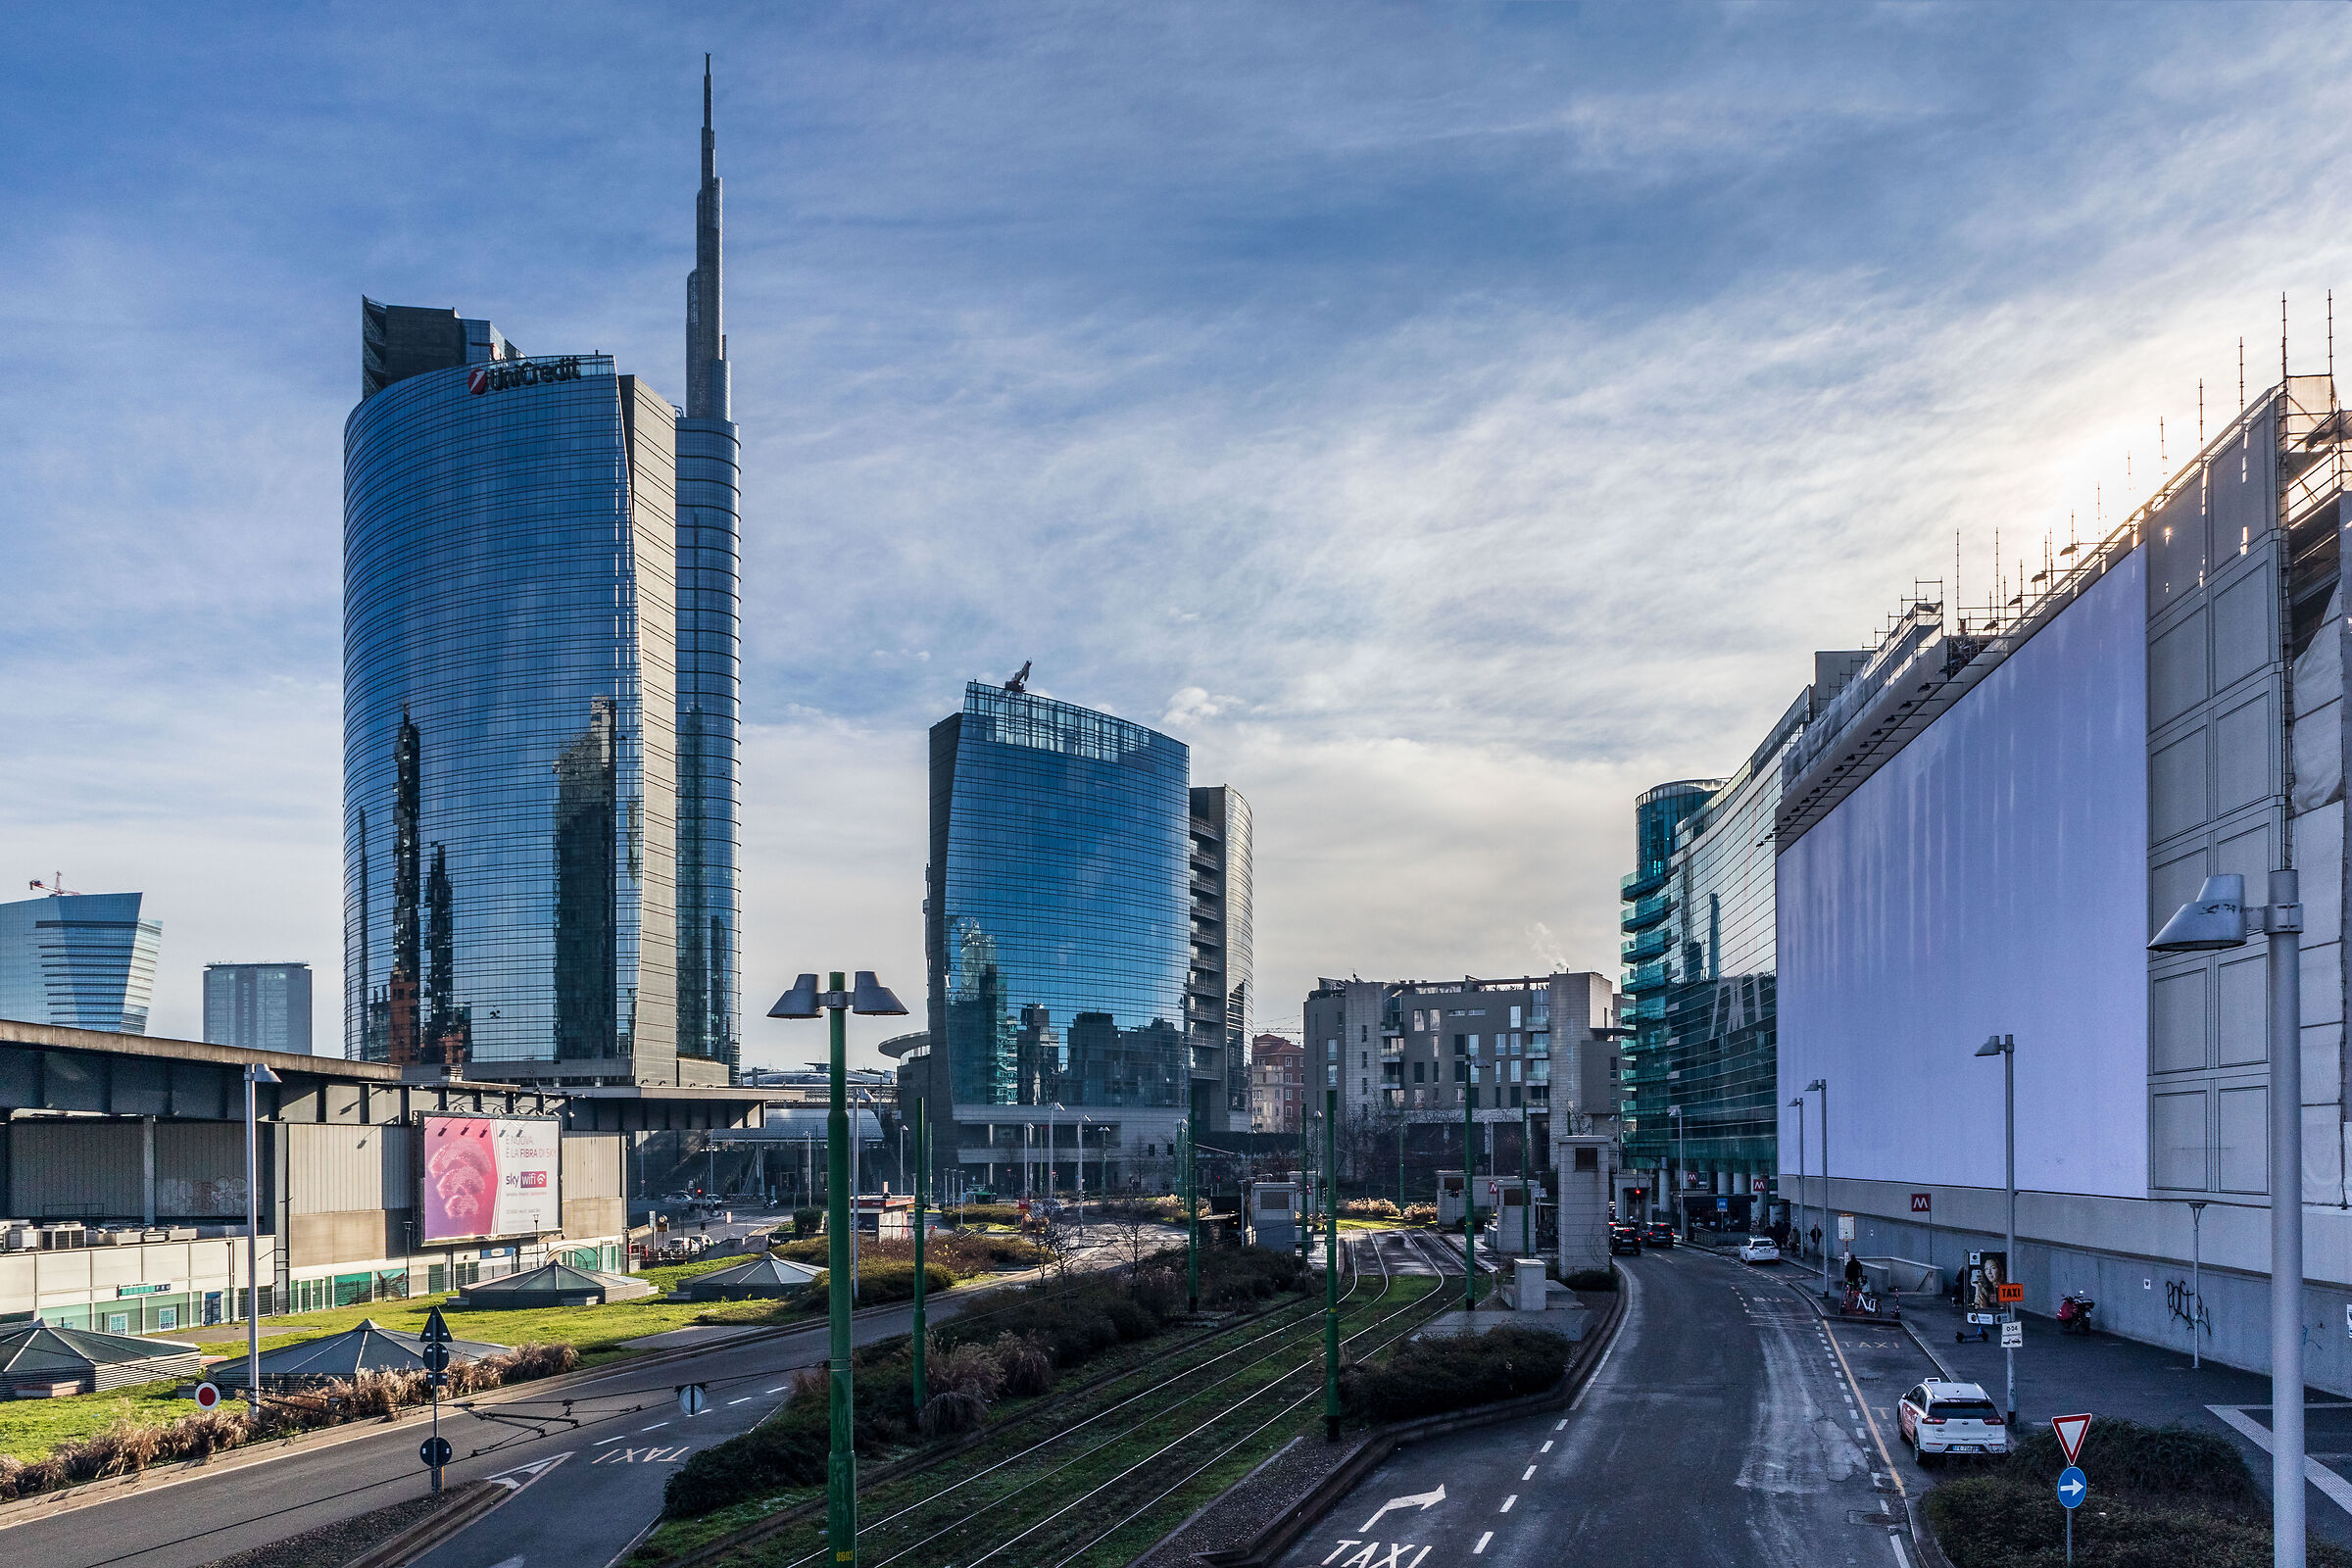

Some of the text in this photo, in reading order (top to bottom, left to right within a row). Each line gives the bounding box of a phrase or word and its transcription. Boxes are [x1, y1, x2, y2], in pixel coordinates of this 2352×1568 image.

[491, 356, 581, 391] UniCredit
[519, 1148, 537, 1158] FIBRA
[506, 1171, 536, 1188] sky wifi
[1913, 1197, 1929, 1208] M
[2001, 1288, 2021, 1298] TAXI
[1838, 1341, 1900, 1349] TAXI
[591, 1446, 690, 1464] TAXI
[1320, 1539, 1433, 1568] TAXI
